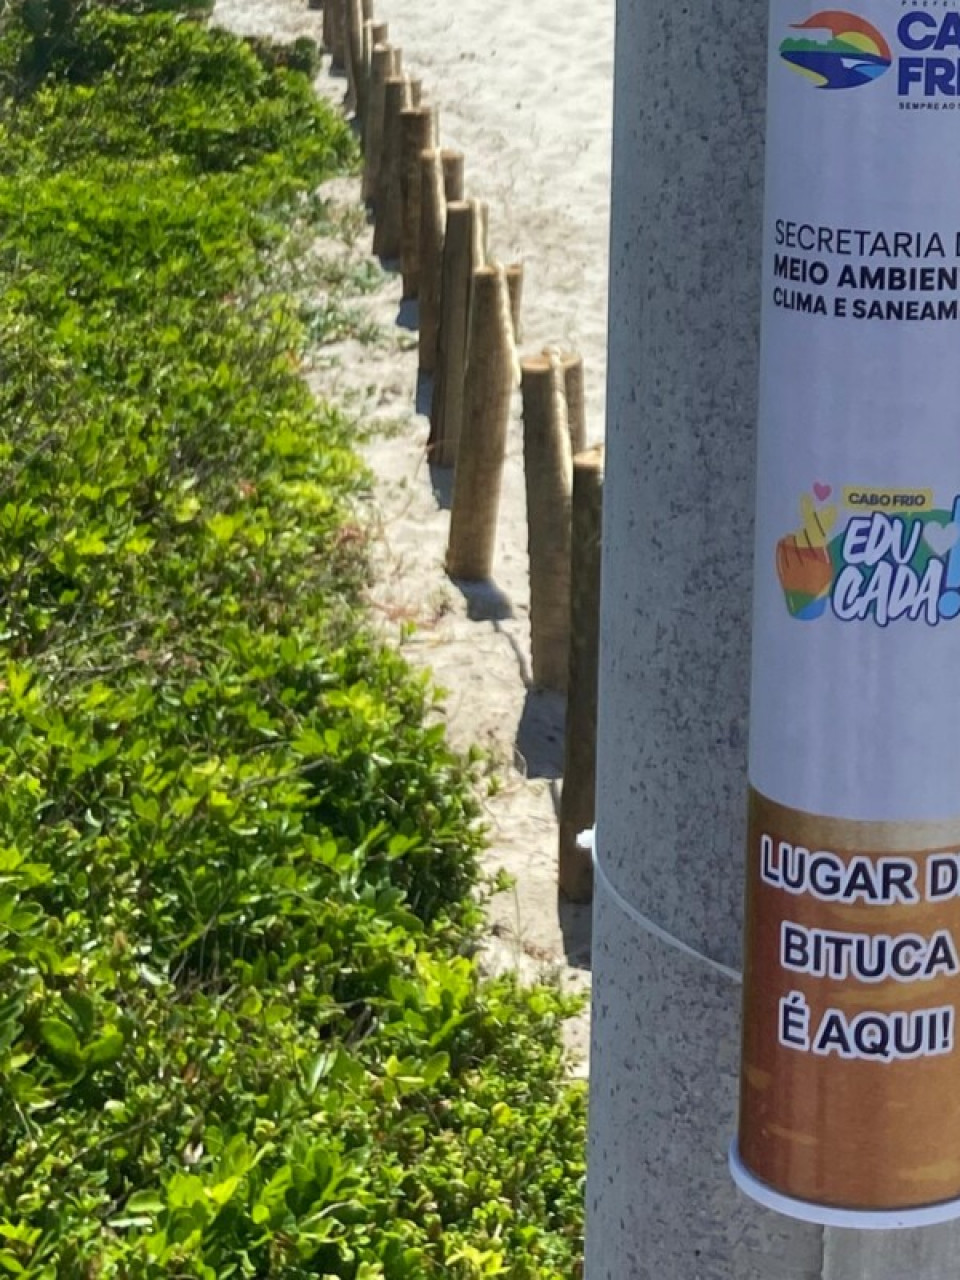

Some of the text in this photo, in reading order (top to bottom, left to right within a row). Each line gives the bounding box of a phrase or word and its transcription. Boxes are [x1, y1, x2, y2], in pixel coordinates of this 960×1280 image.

[899, 101, 940, 111] SEMPRE
[942, 101, 956, 111] AO
[775, 218, 946, 258] SECRETARIA
[773, 253, 829, 286] MEIO
[772, 286, 828, 316] CLIMA
[834, 297, 847, 317] E
[847, 492, 926, 507] CABO FRIO
[842, 511, 922, 566] EDU
[760, 834, 919, 904] LUGAR
[781, 921, 960, 985] BITUCA
[779, 991, 955, 1063] É AQUI!
